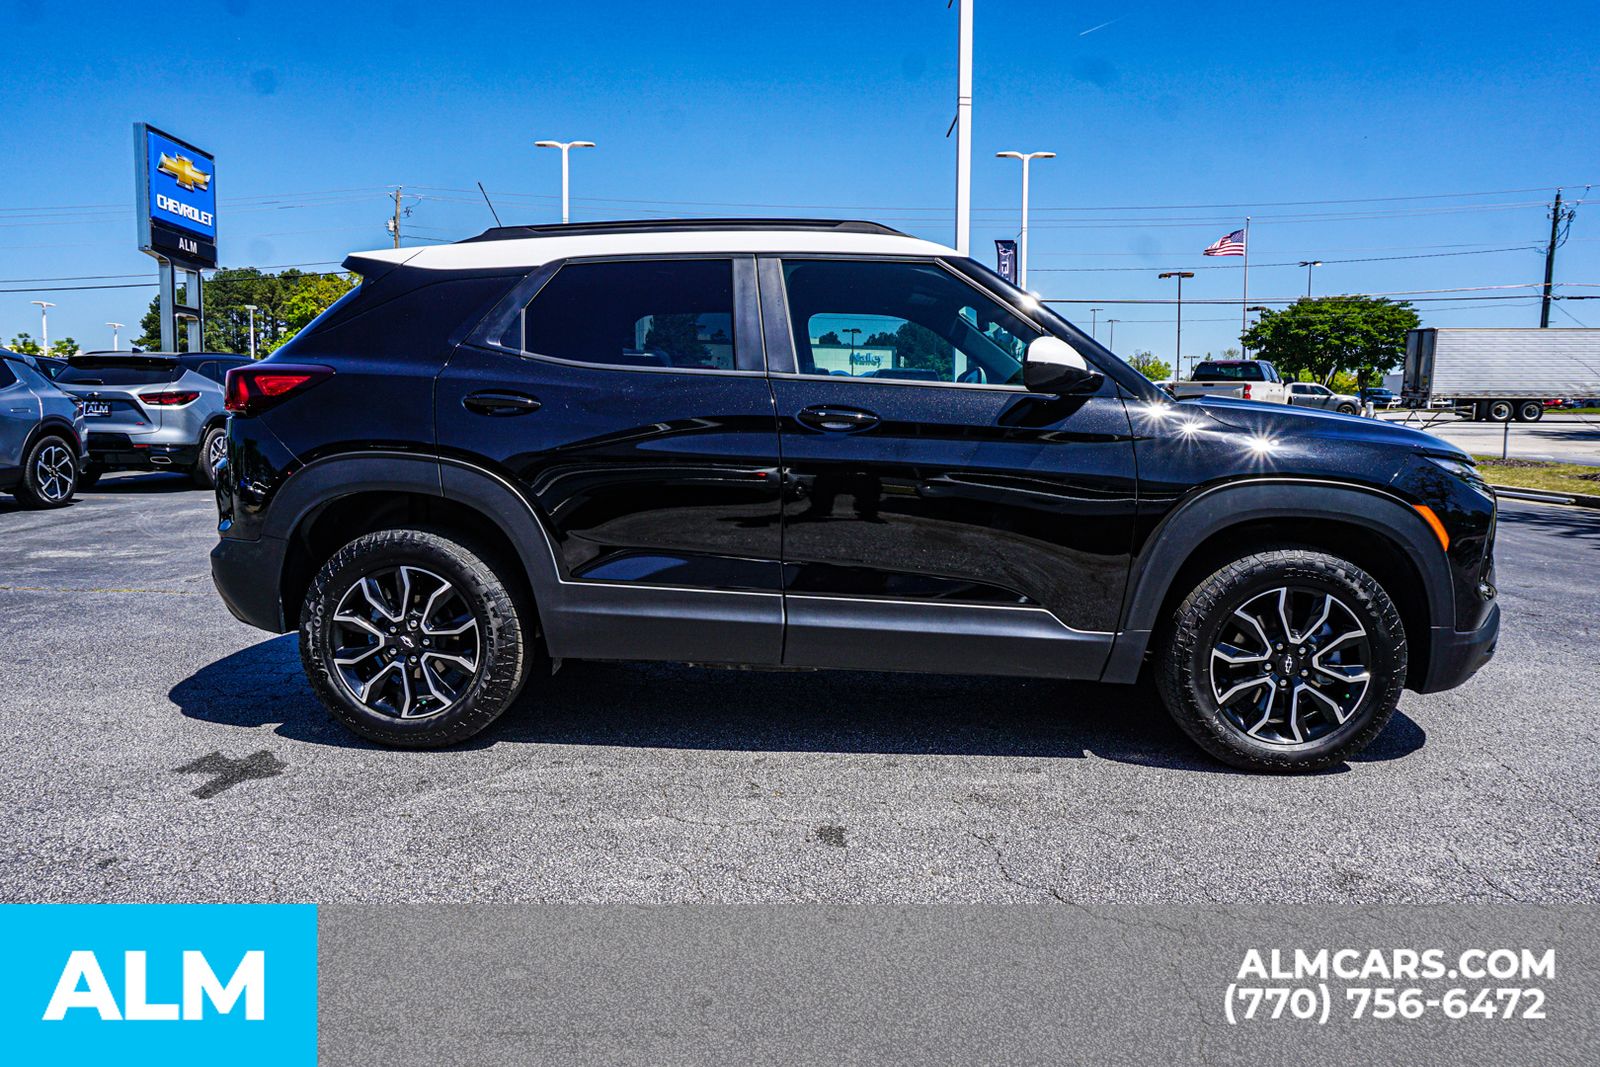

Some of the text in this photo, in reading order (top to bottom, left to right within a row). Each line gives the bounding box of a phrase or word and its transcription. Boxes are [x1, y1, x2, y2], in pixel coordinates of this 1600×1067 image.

[157, 194, 213, 226] CHEVROLET
[179, 237, 198, 254] ALM
[87, 405, 109, 413] ALM
